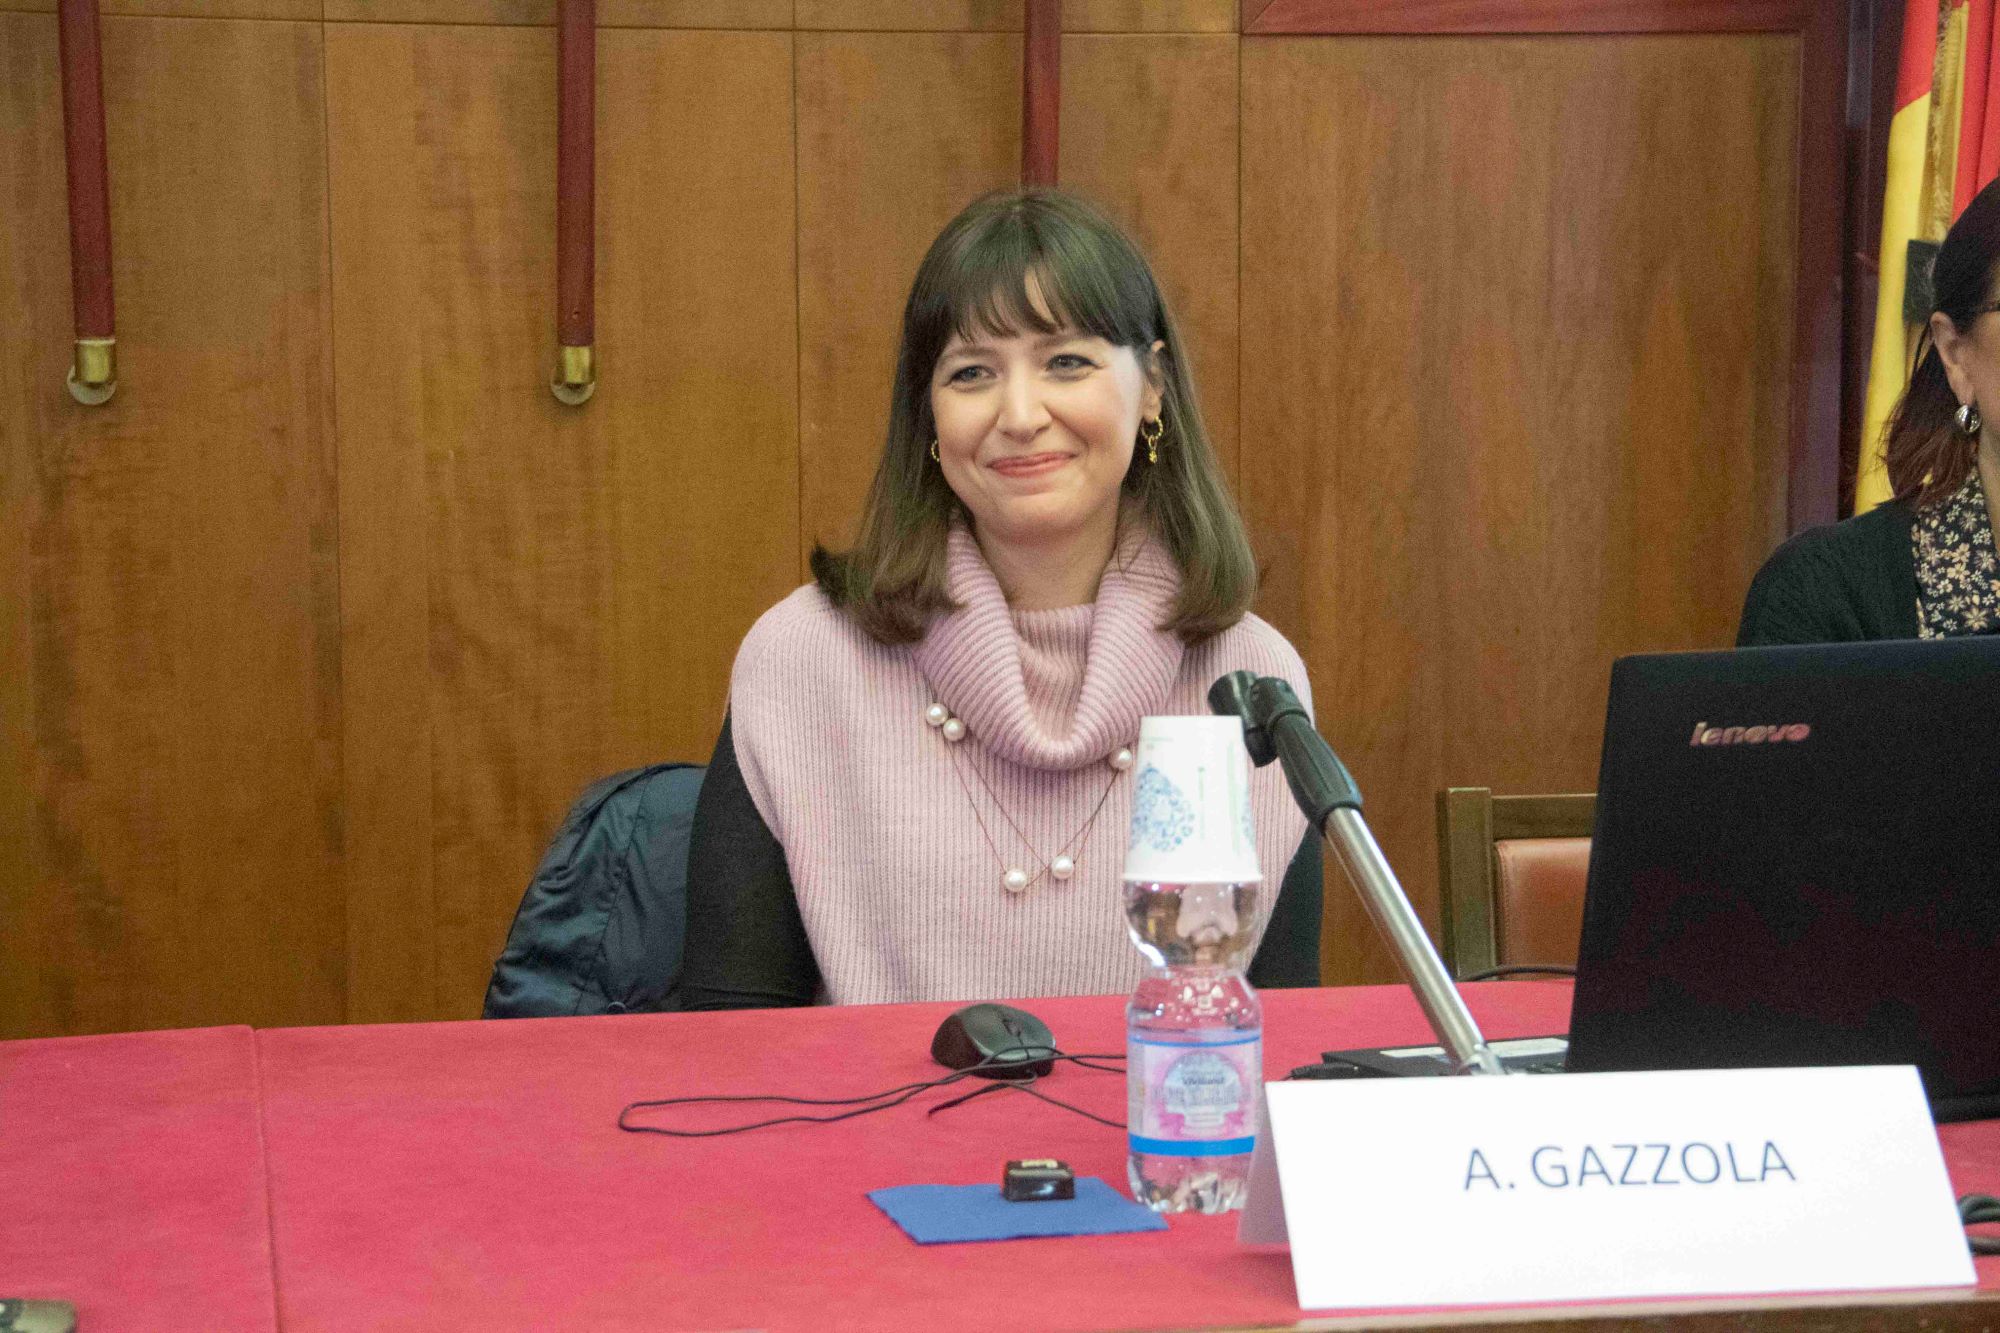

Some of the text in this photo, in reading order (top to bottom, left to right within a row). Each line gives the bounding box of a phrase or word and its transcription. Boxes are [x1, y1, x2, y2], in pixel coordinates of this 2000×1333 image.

[1690, 721, 1810, 747] lenovo
[1464, 1140, 1797, 1191] A. GAZZOLA
